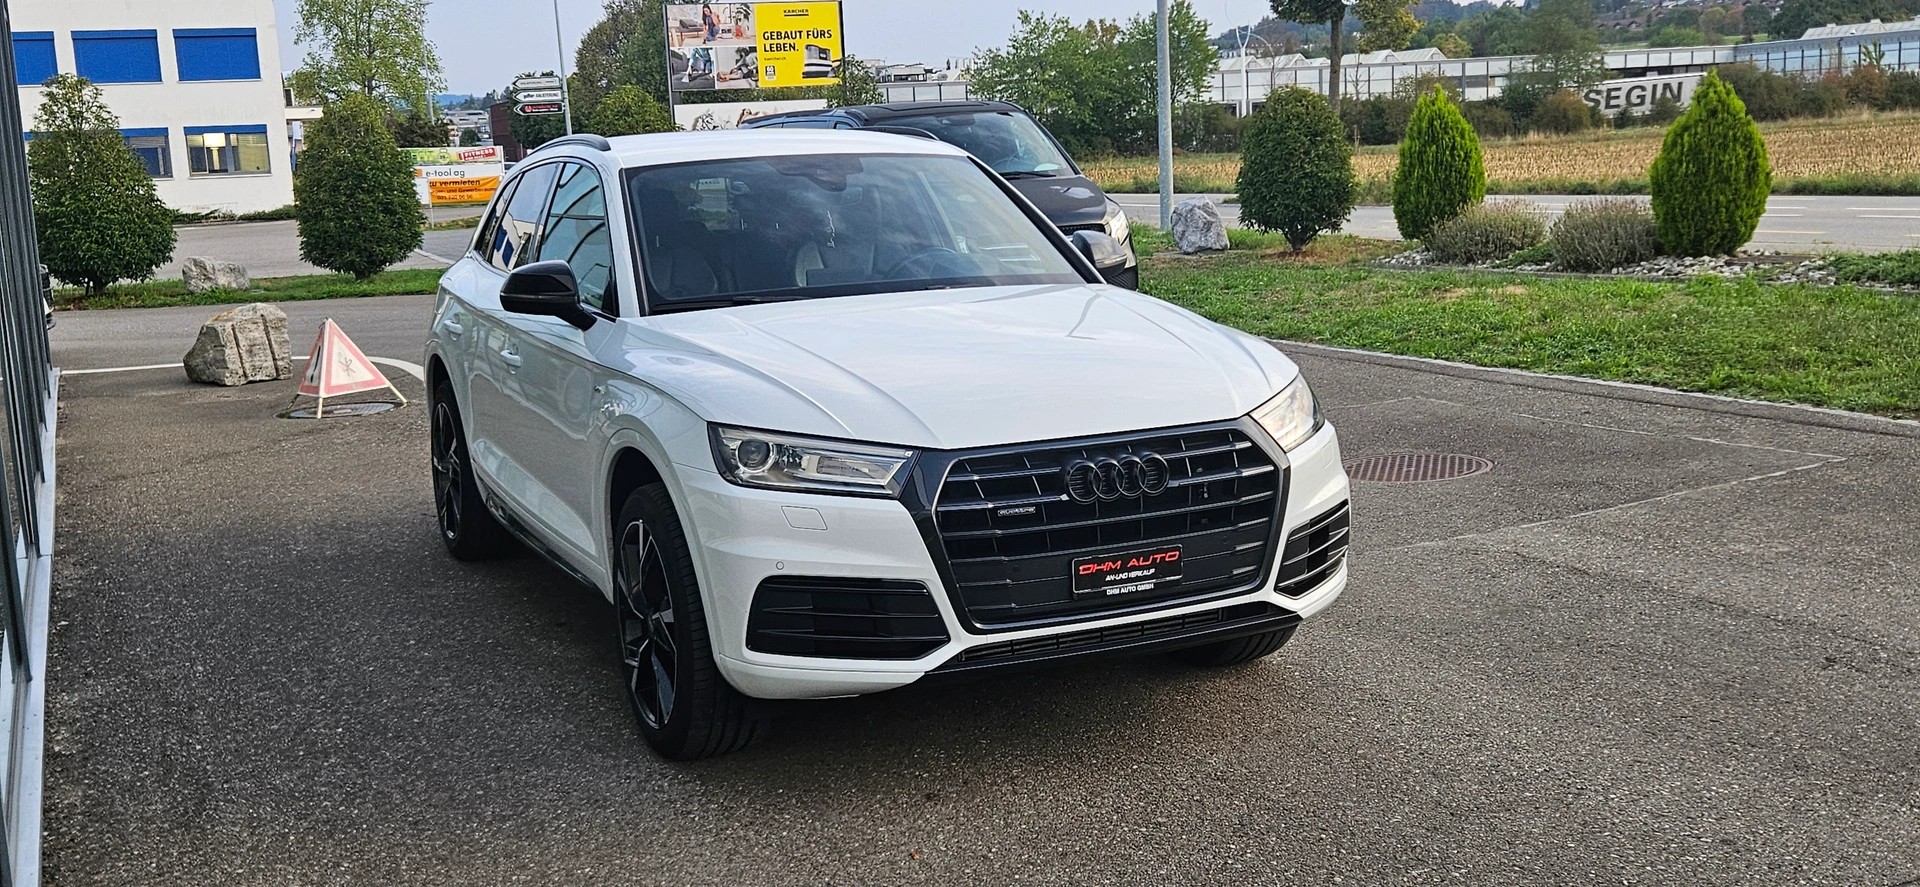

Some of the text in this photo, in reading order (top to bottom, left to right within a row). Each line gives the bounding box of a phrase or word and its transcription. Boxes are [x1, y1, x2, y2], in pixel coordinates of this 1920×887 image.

[763, 28, 832, 40] GEBAUT FÜRS
[763, 43, 799, 53] LEBEN.
[1583, 82, 1683, 109] SEGIN
[425, 168, 465, 178] e-tool ag
[1127, 551, 1179, 567] AUTO
[1120, 585, 1137, 593] AUTO
